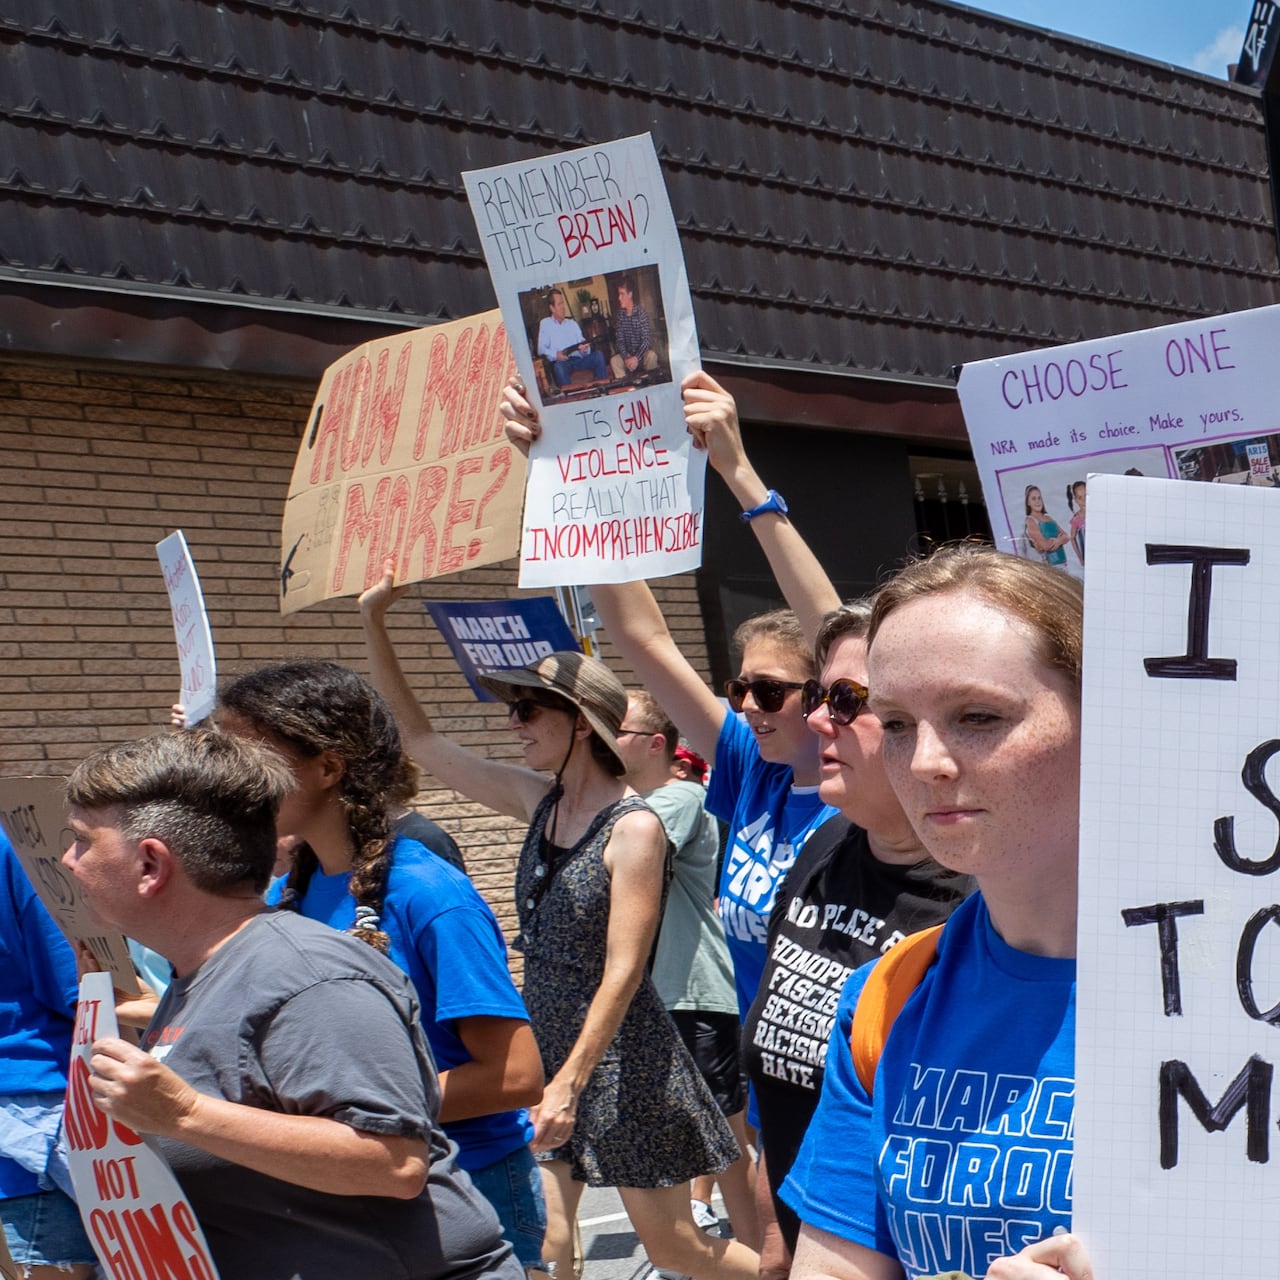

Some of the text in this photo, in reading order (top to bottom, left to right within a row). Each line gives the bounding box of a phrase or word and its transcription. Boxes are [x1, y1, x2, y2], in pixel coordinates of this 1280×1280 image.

[477, 151, 622, 231] REMEMBER
[1001, 329, 1236, 410] CHOOSE ONE
[310, 322, 517, 486] HOW MAN
[575, 395, 652, 442] IS GUN
[990, 408, 1245, 456] NRA made its choice. Make yours.
[556, 435, 670, 484] VIOLENCE
[1250, 456, 1268, 467] SALE
[332, 447, 513, 593] MORE?
[552, 473, 682, 522] REALLY THAT
[448, 614, 532, 642] MARCH
[1143, 542, 1252, 682] I
[462, 642, 509, 667] FOR
[785, 896, 819, 928] NO
[820, 904, 886, 946] PLACE
[768, 965, 840, 1015] FASCIS
[753, 1019, 828, 1068] RACISM
[760, 1051, 816, 1090] HATE
[893, 1062, 1075, 1141] MARC
[92, 1156, 140, 1201] NOT
[878, 1133, 1000, 1208] FOR
